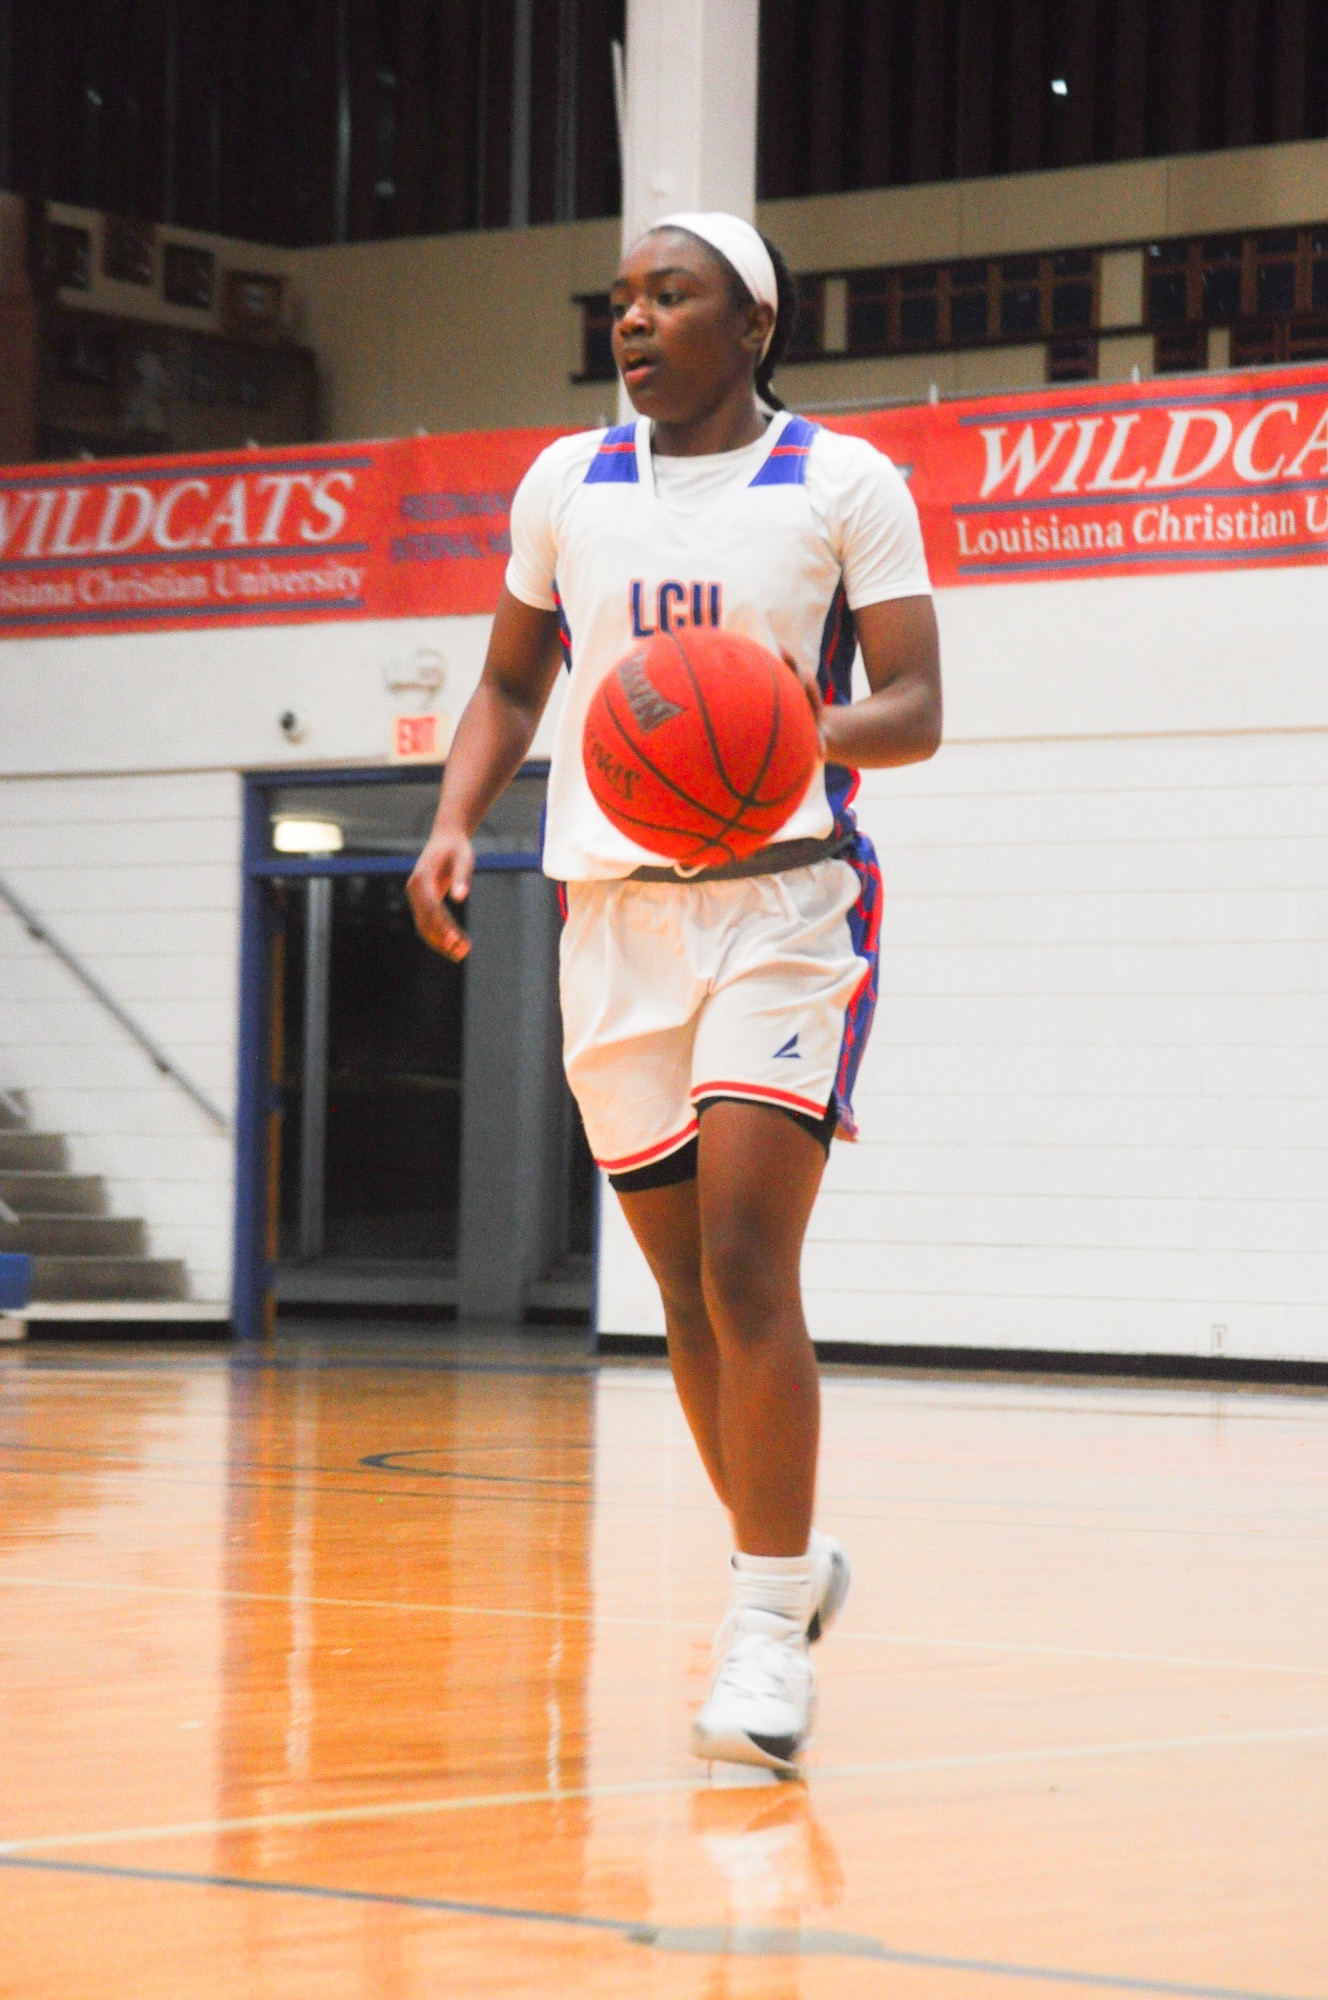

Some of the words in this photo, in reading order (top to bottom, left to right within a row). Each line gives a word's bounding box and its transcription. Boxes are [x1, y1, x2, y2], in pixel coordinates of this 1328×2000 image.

[978, 400, 1328, 498] WILDCA
[955, 513, 1124, 557] Louisiana
[1131, 501, 1298, 545] Christian
[627, 577, 723, 641] LCU
